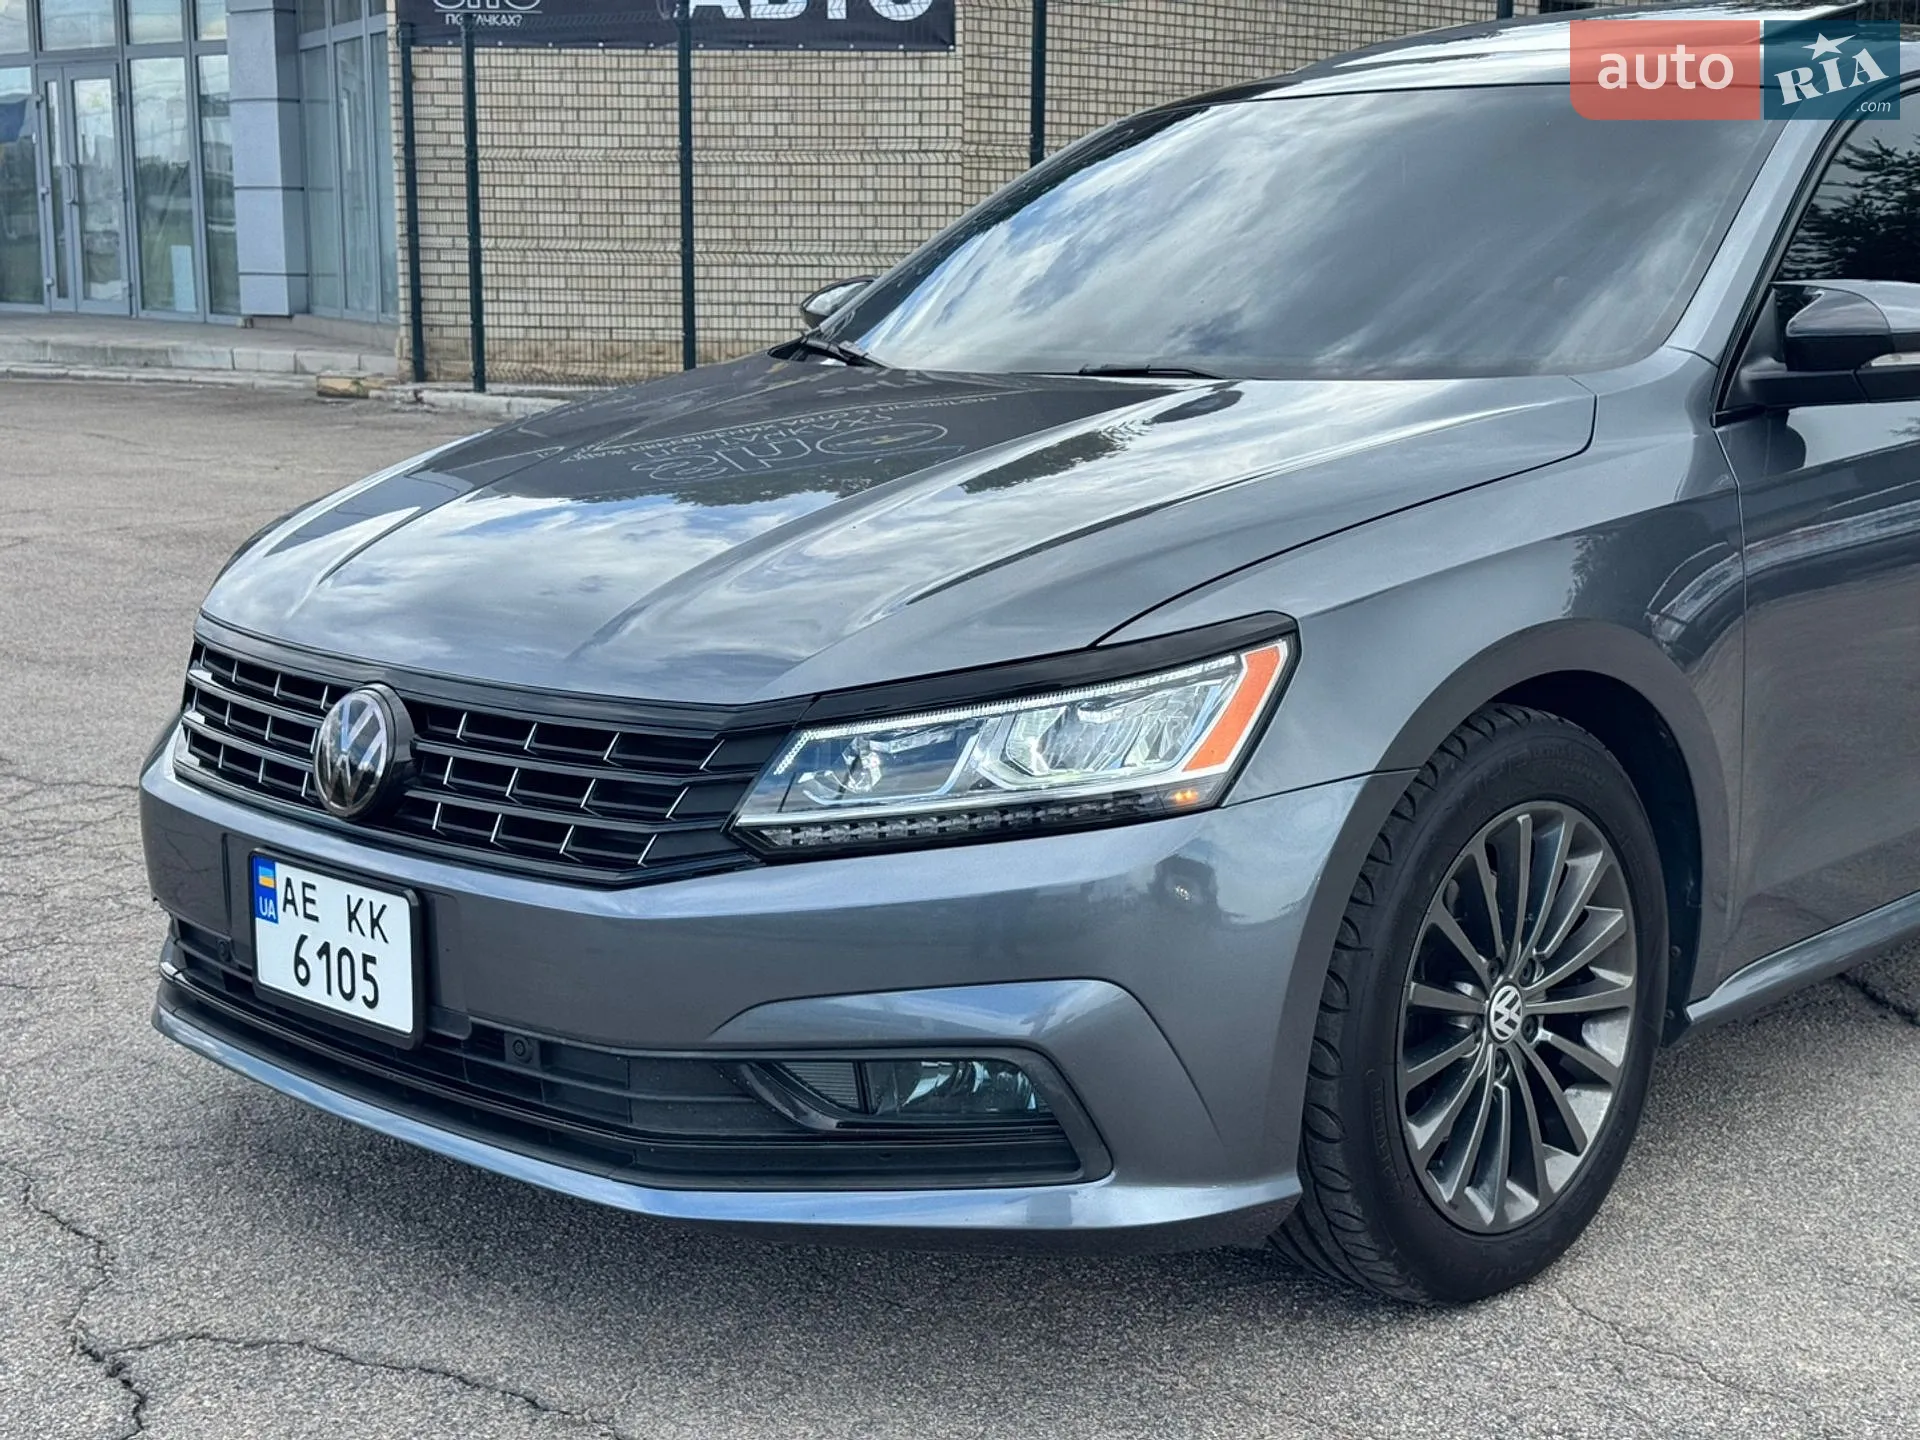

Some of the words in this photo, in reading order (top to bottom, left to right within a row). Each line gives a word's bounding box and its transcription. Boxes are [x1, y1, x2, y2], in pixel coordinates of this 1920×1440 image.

[472, 14, 523, 28] АЧКАХ?
[258, 896, 277, 920] UA
[282, 877, 320, 923] AE
[346, 894, 390, 944] KK
[293, 933, 380, 1010] 6105
